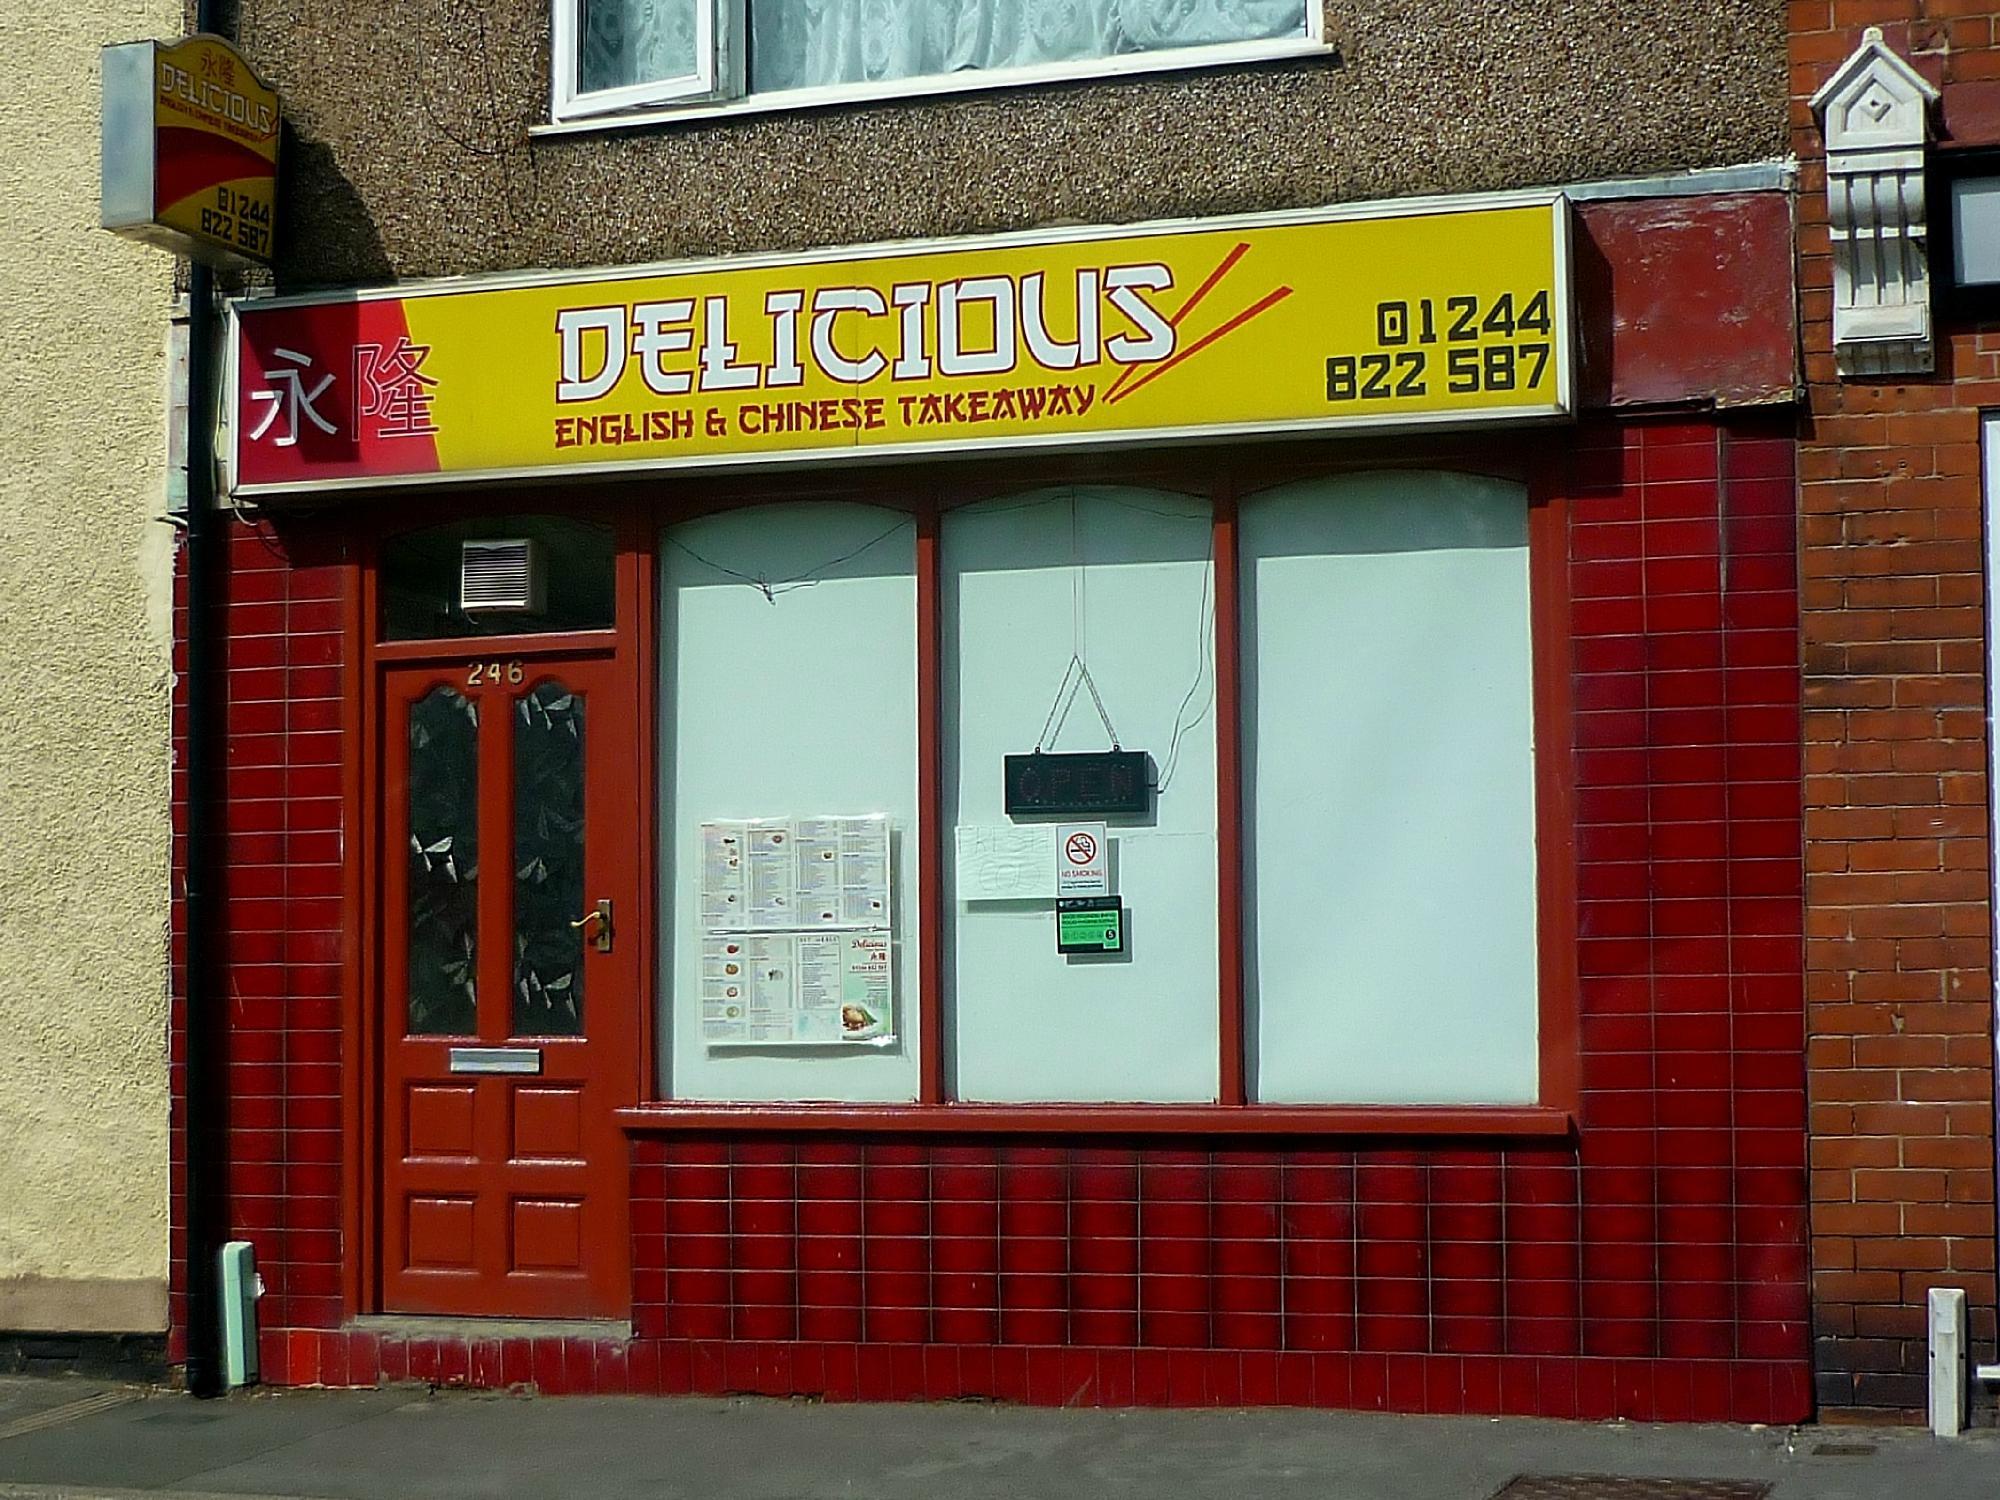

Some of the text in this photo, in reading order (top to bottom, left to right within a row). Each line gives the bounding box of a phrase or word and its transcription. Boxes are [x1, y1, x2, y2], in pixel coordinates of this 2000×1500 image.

[161, 63, 270, 133] DELICIOUS
[202, 208, 269, 253] 822 587
[218, 187, 269, 227] 01244
[555, 263, 1176, 403] DELICIOUS
[1377, 290, 1550, 346] 01244
[250, 337, 441, 446] 永隆
[1327, 343, 1550, 400] 822 587
[555, 384, 1095, 448] ENGLISH & CHINESE TAKEAWAY
[467, 660, 525, 685] 246
